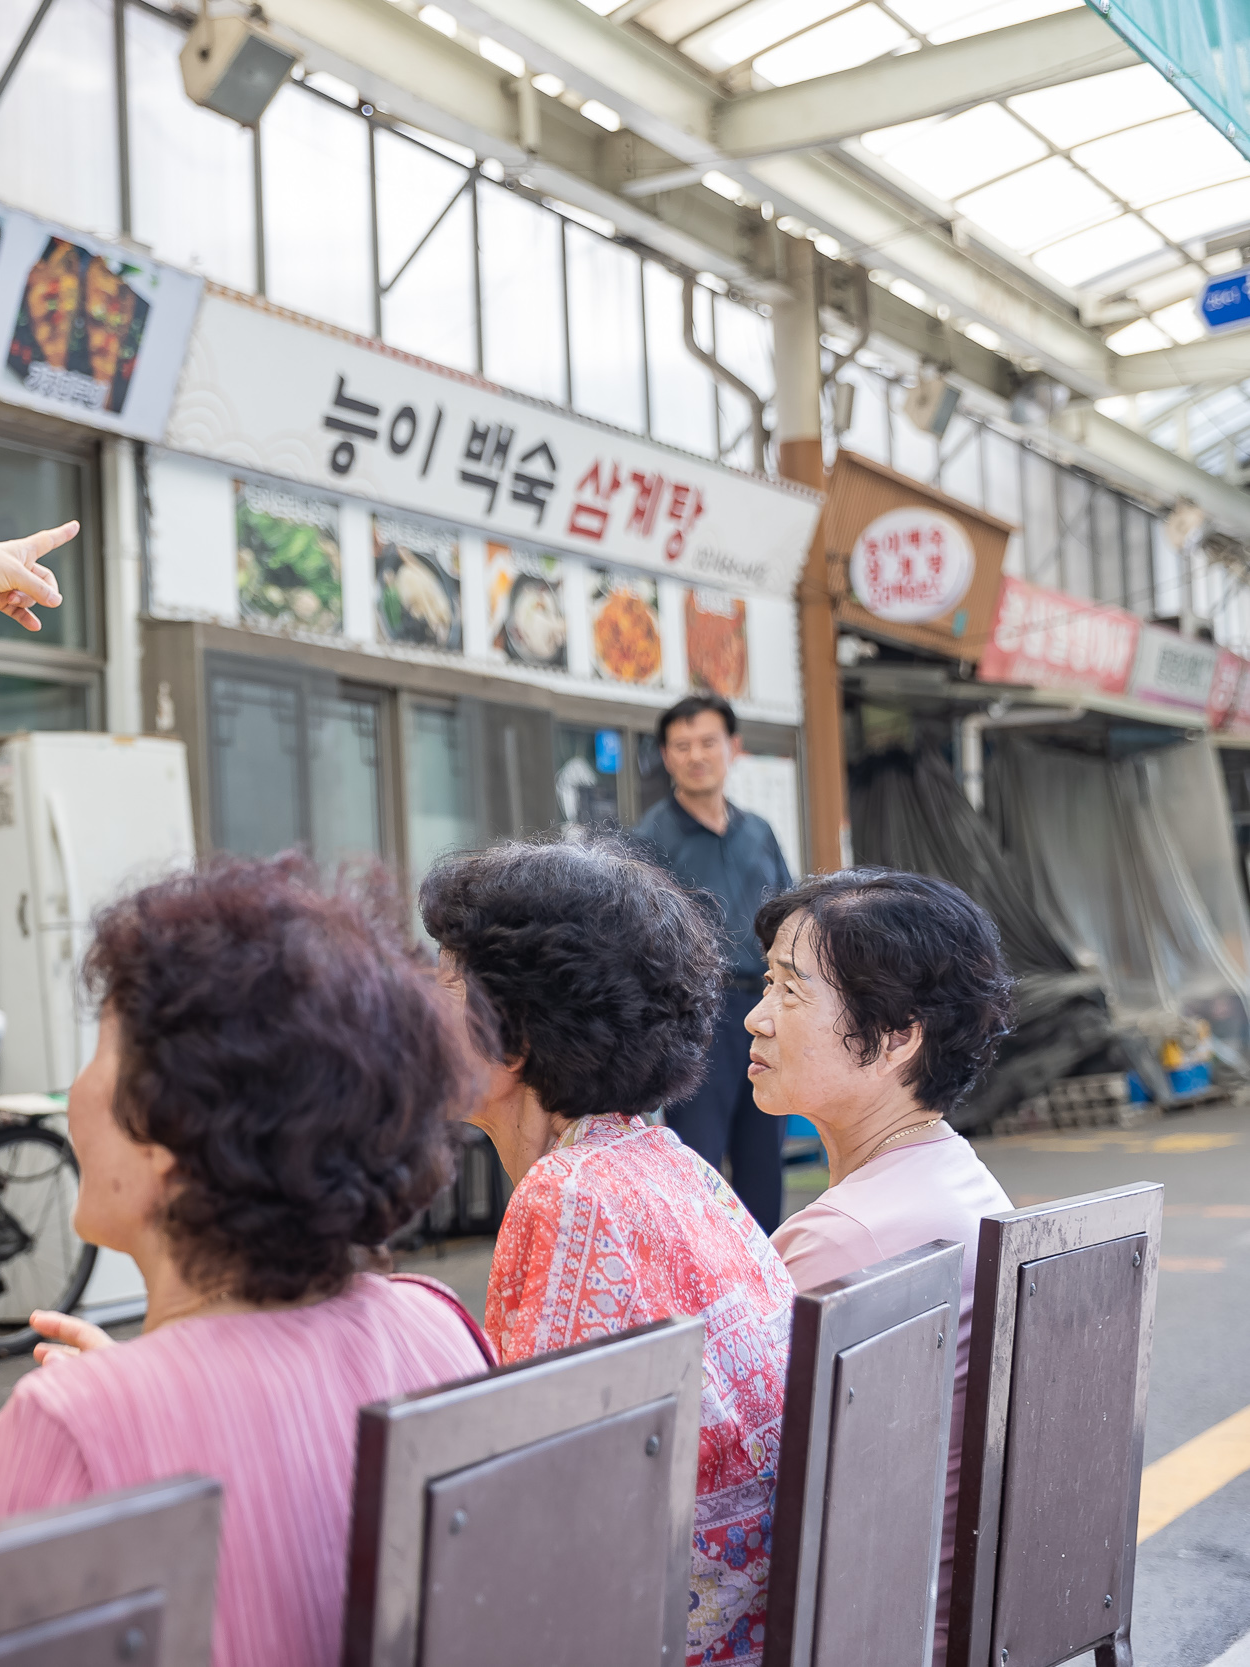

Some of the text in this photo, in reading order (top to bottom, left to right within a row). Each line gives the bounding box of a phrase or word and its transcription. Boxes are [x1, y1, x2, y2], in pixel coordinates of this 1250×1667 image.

[323, 371, 444, 478] 능이
[459, 418, 558, 525] 백숙
[567, 458, 705, 562] 삼계탕
